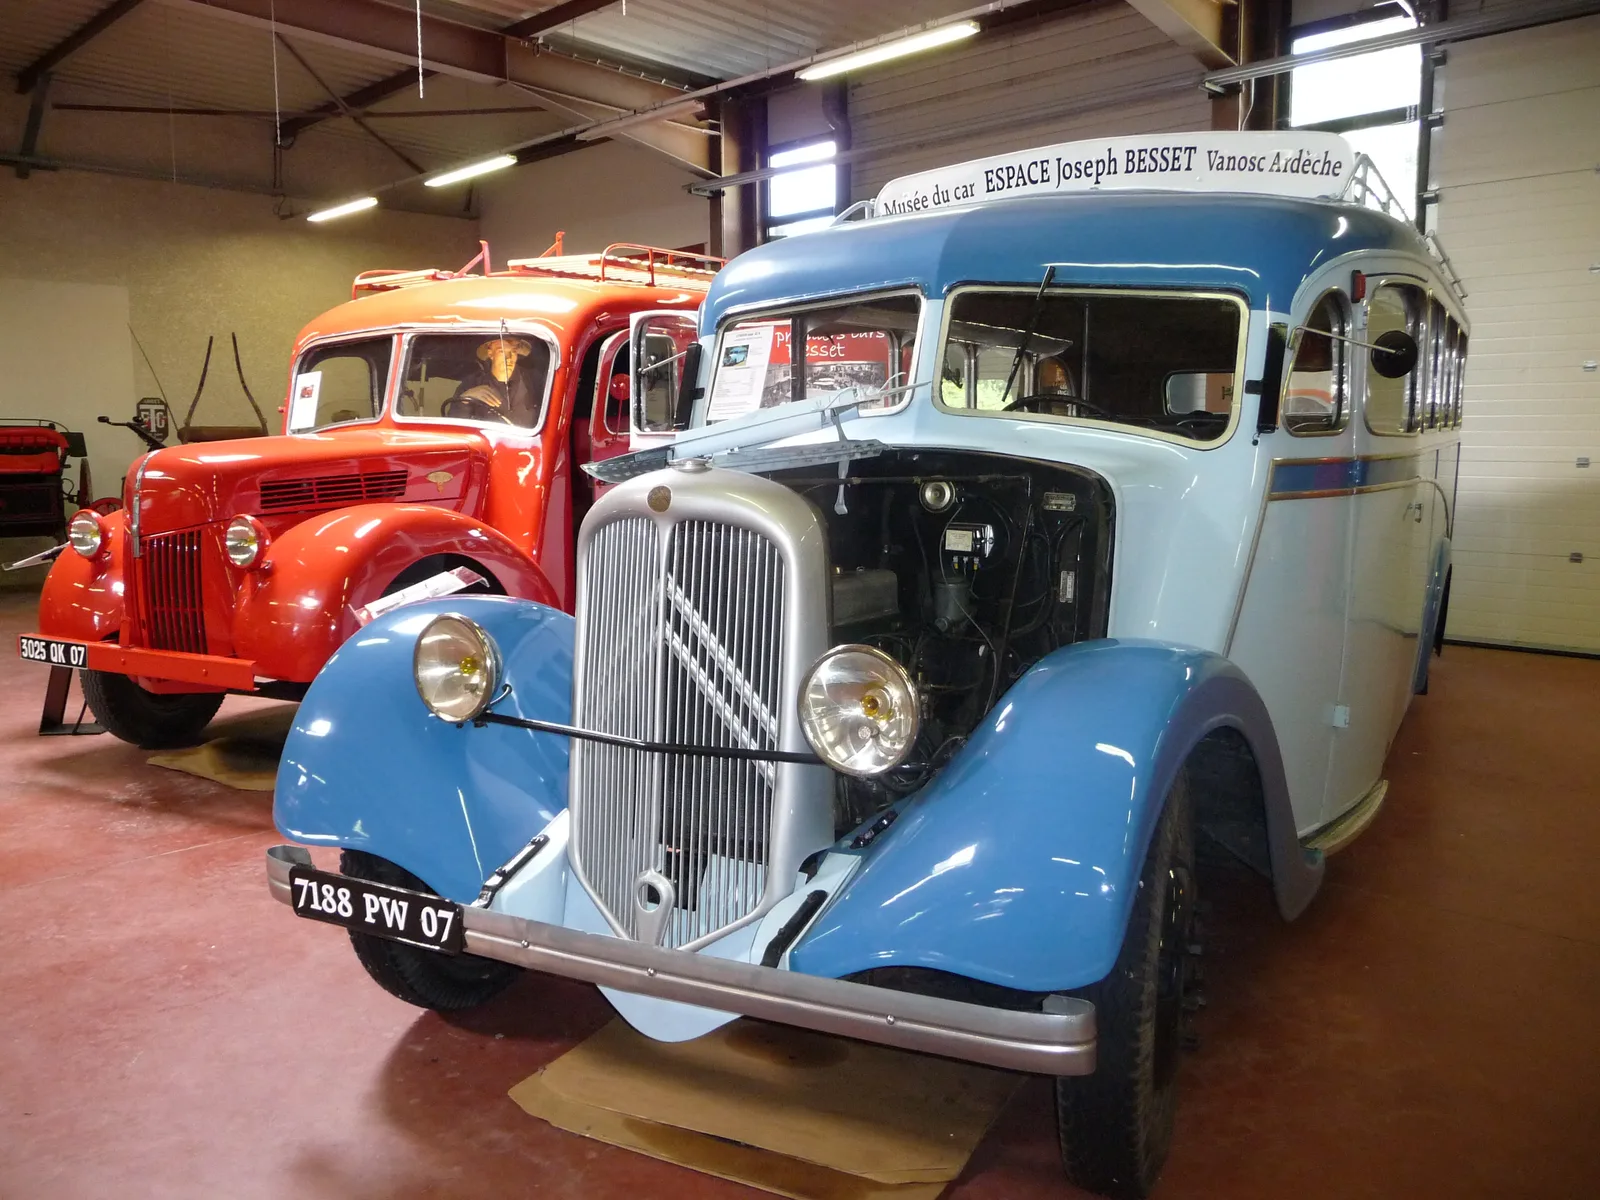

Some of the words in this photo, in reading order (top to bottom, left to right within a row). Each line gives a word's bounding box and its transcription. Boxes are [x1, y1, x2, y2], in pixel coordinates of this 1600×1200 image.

[884, 190, 929, 216] Musée
[932, 184, 951, 206] du
[953, 182, 976, 201] car
[984, 158, 1051, 194] ESPACE
[1055, 147, 1118, 189] Joseph
[1124, 146, 1197, 174] BESSET
[1207, 150, 1266, 172] Vanosc
[1268, 149, 1342, 177] Ardèche
[21, 639, 46, 660] 3025
[50, 643, 66, 663] QK
[70, 645, 85, 665] 07
[294, 877, 353, 918] 7188
[362, 893, 409, 931] PW
[420, 906, 454, 942] 07
